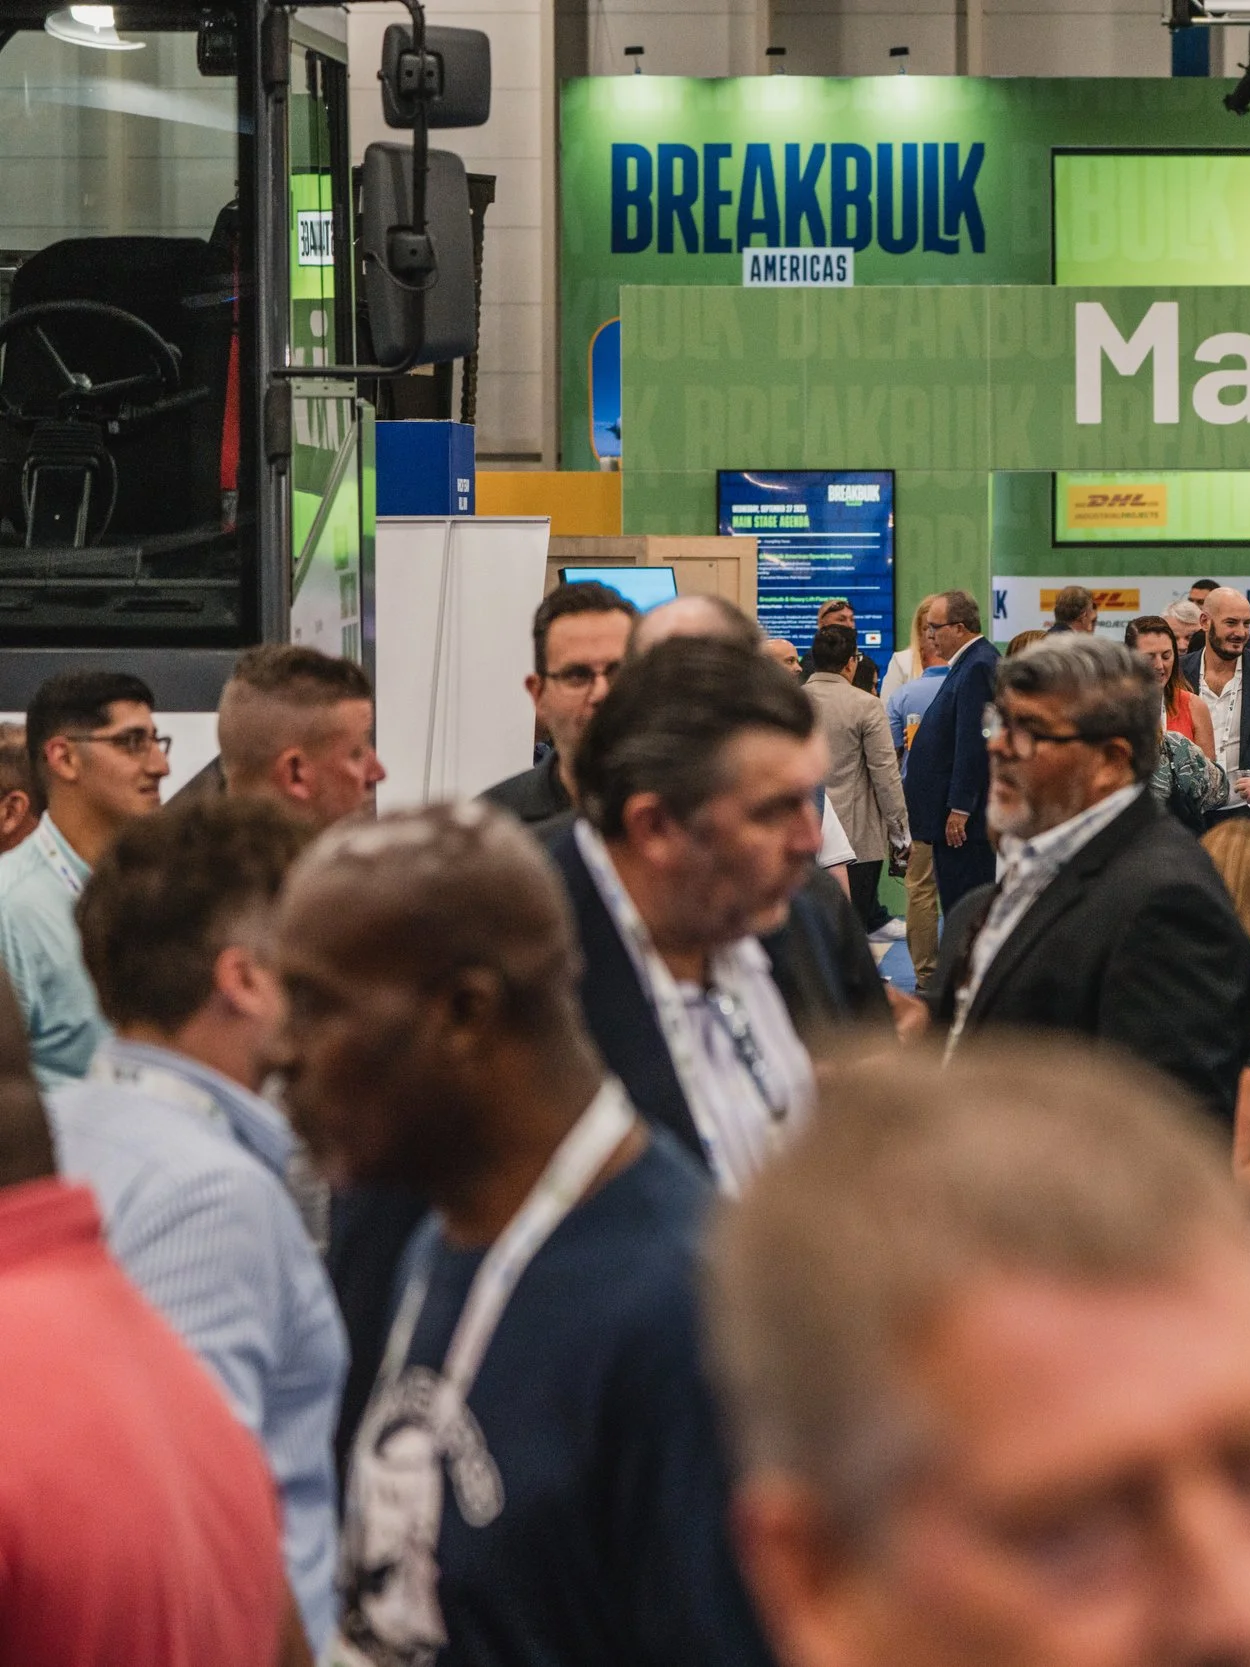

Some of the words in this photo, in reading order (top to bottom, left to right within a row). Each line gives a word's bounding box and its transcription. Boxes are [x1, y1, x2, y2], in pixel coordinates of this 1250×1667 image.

[611, 142, 985, 254] BREAKBULK
[750, 255, 847, 282] AMERICAS
[1087, 494, 1146, 507] DHL
[732, 515, 752, 528] MAIN
[754, 515, 777, 528] STAGE
[779, 515, 810, 528] AGENDA
